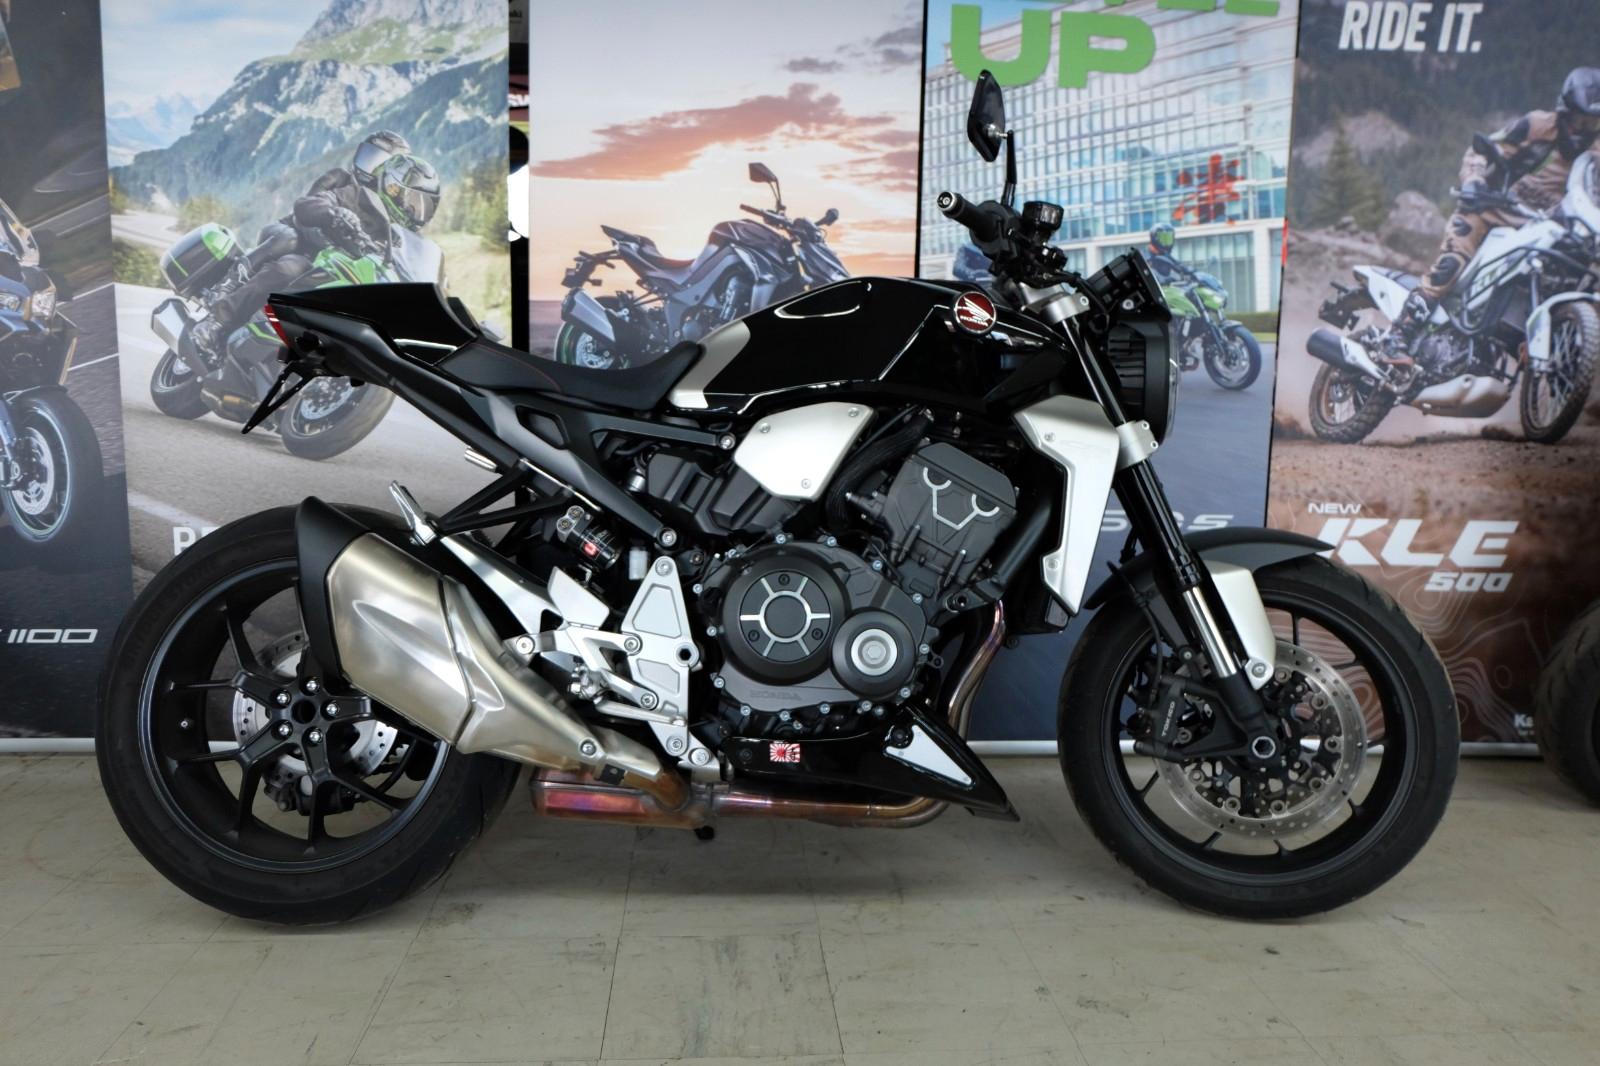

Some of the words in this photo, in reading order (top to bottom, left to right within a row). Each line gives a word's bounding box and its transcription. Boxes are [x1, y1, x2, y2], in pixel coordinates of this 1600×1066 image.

[1338, 1, 1433, 52] RIDE
[1437, 2, 1484, 53] IT.
[950, 4, 1156, 89] UP
[960, 315, 989, 327] HONDA
[1307, 502, 1362, 514] NEW
[1314, 517, 1520, 567] KLE
[1423, 571, 1514, 593] 500
[7, 628, 99, 644] 1100
